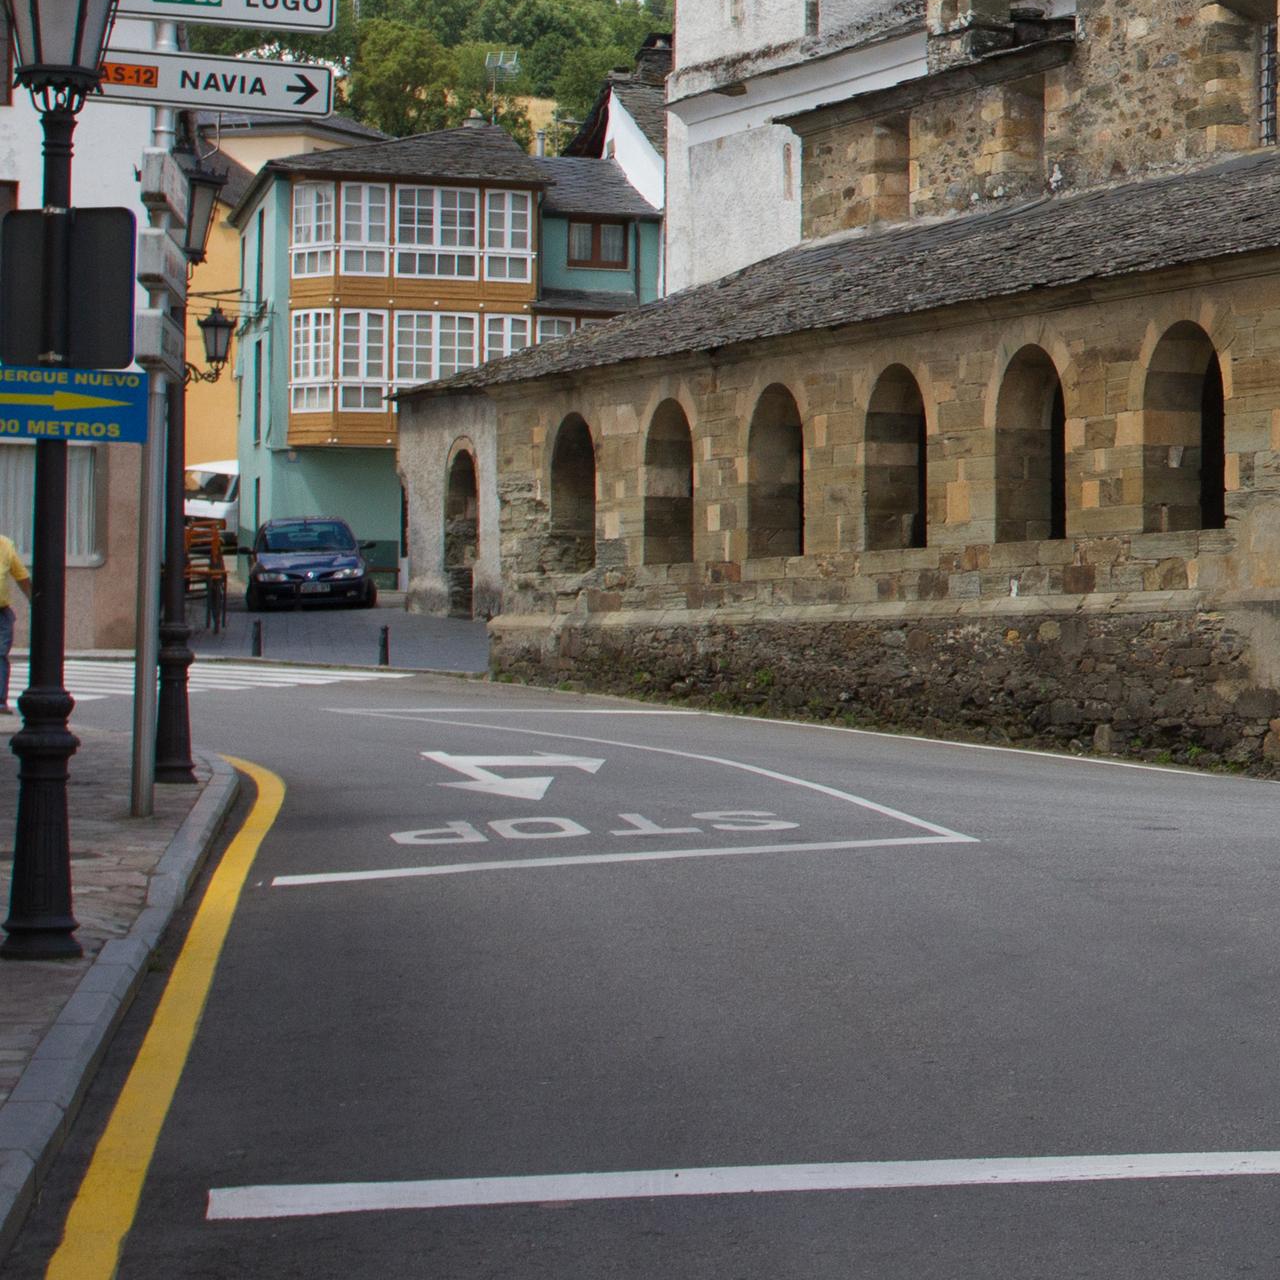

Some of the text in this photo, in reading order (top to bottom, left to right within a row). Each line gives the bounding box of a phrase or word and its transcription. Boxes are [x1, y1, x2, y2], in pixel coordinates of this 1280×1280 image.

[99, 64, 267, 96] AS-12 NAVIA
[0, 369, 140, 388] ERGUE NUEVO
[27, 420, 121, 438] METROS
[389, 810, 801, 845] STOP
